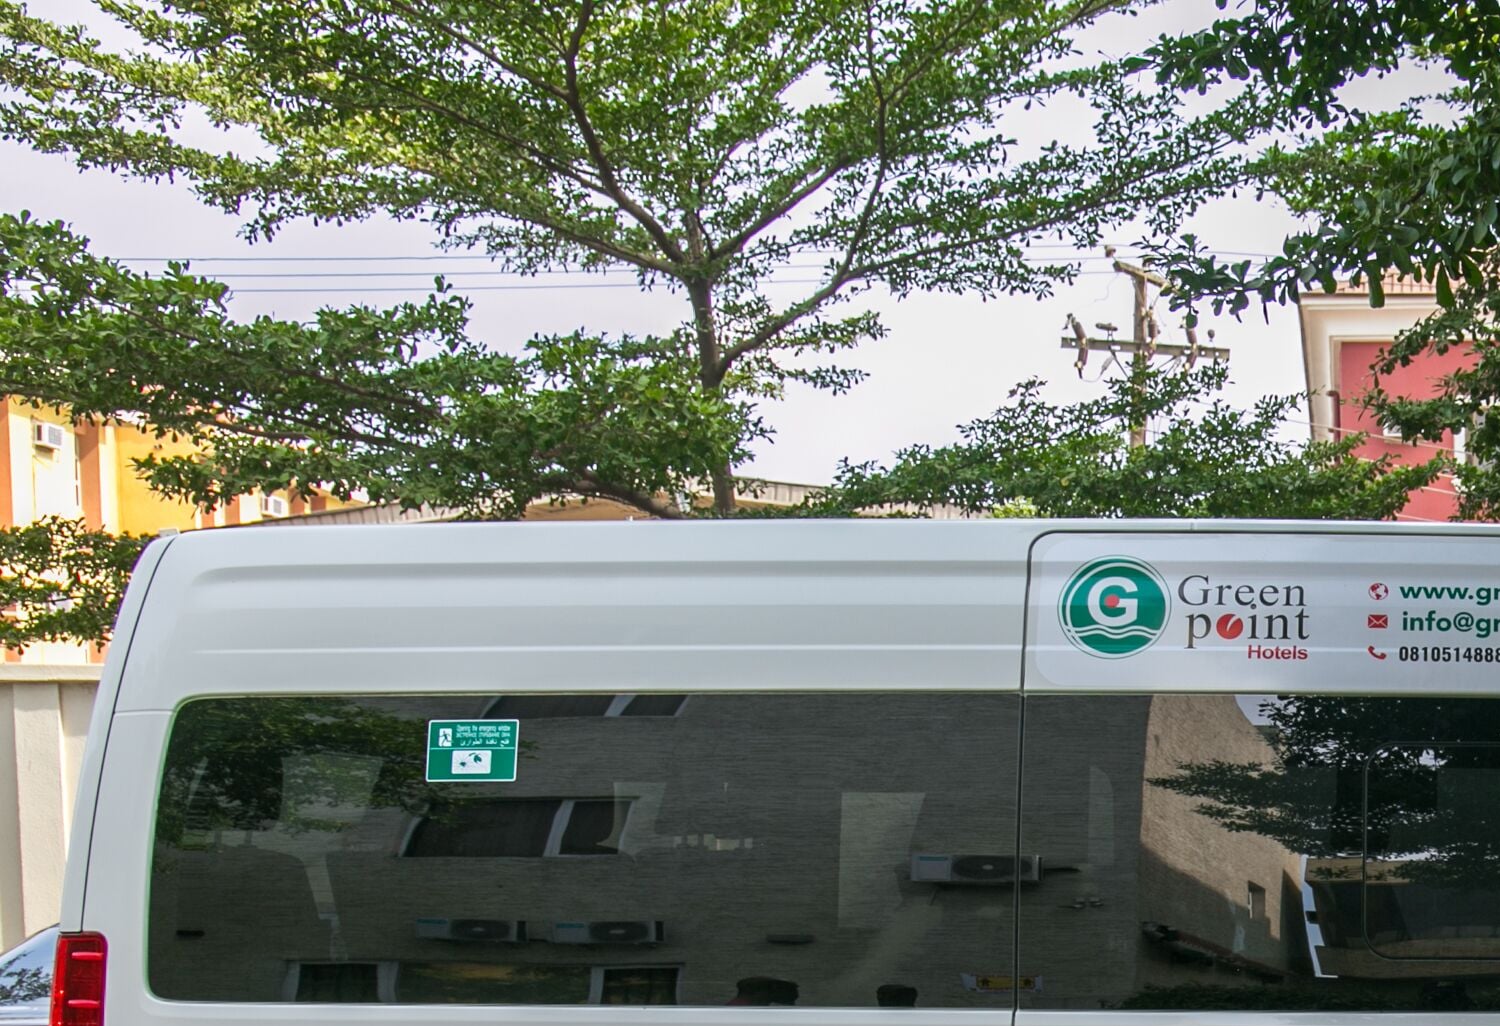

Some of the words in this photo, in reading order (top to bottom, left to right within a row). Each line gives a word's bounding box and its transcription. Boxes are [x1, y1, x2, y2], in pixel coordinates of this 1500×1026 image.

[1178, 574, 1308, 607] Green
[1184, 604, 1310, 650] point
[1247, 644, 1309, 661] Hotels
